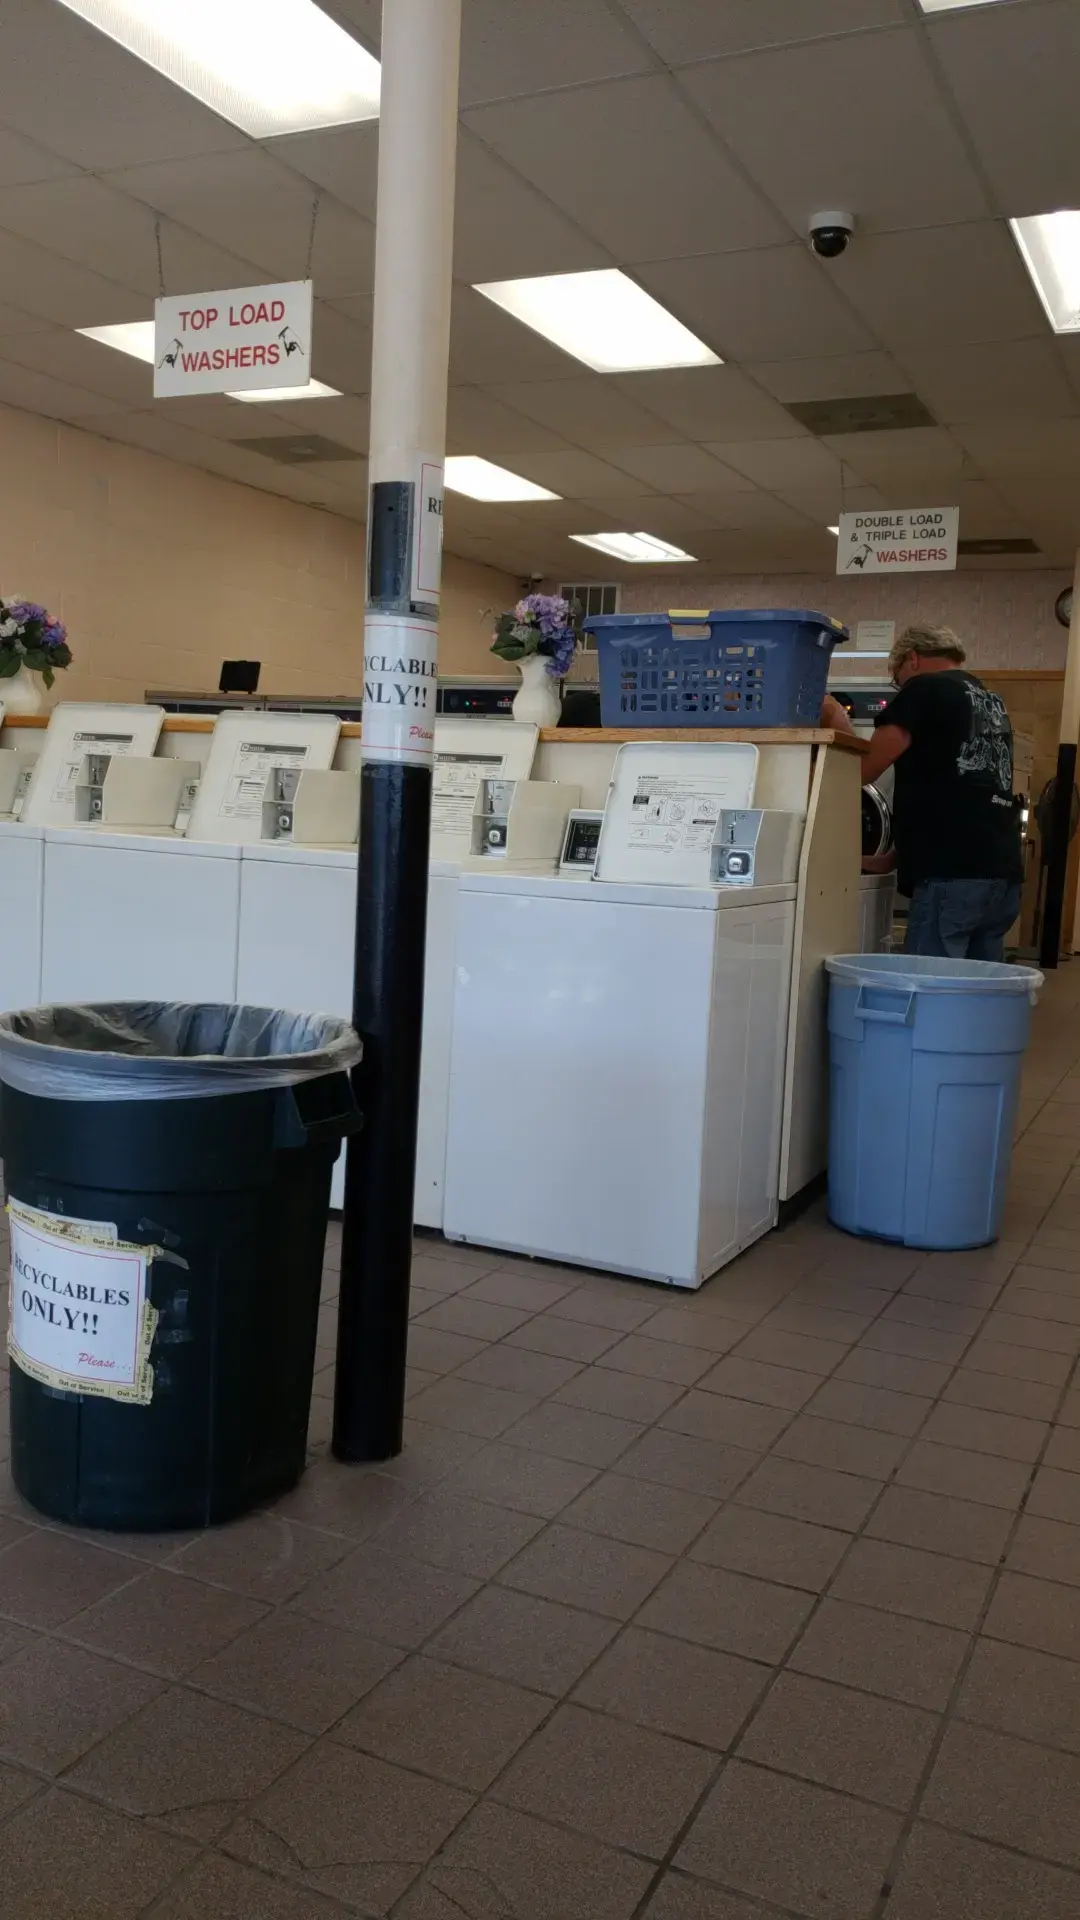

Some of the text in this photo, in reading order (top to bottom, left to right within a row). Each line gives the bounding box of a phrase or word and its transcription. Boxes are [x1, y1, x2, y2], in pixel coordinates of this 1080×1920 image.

[178, 300, 285, 331] TOP LOAD
[181, 344, 280, 372] WASHERS
[850, 528, 946, 542] & TRIPLE LOAD
[855, 514, 943, 528] DOUBLE LOAD
[876, 548, 948, 563] WASHERS
[14, 1251, 130, 1306] RECYCLABLES
[22, 1290, 98, 1335] ONLY!!
